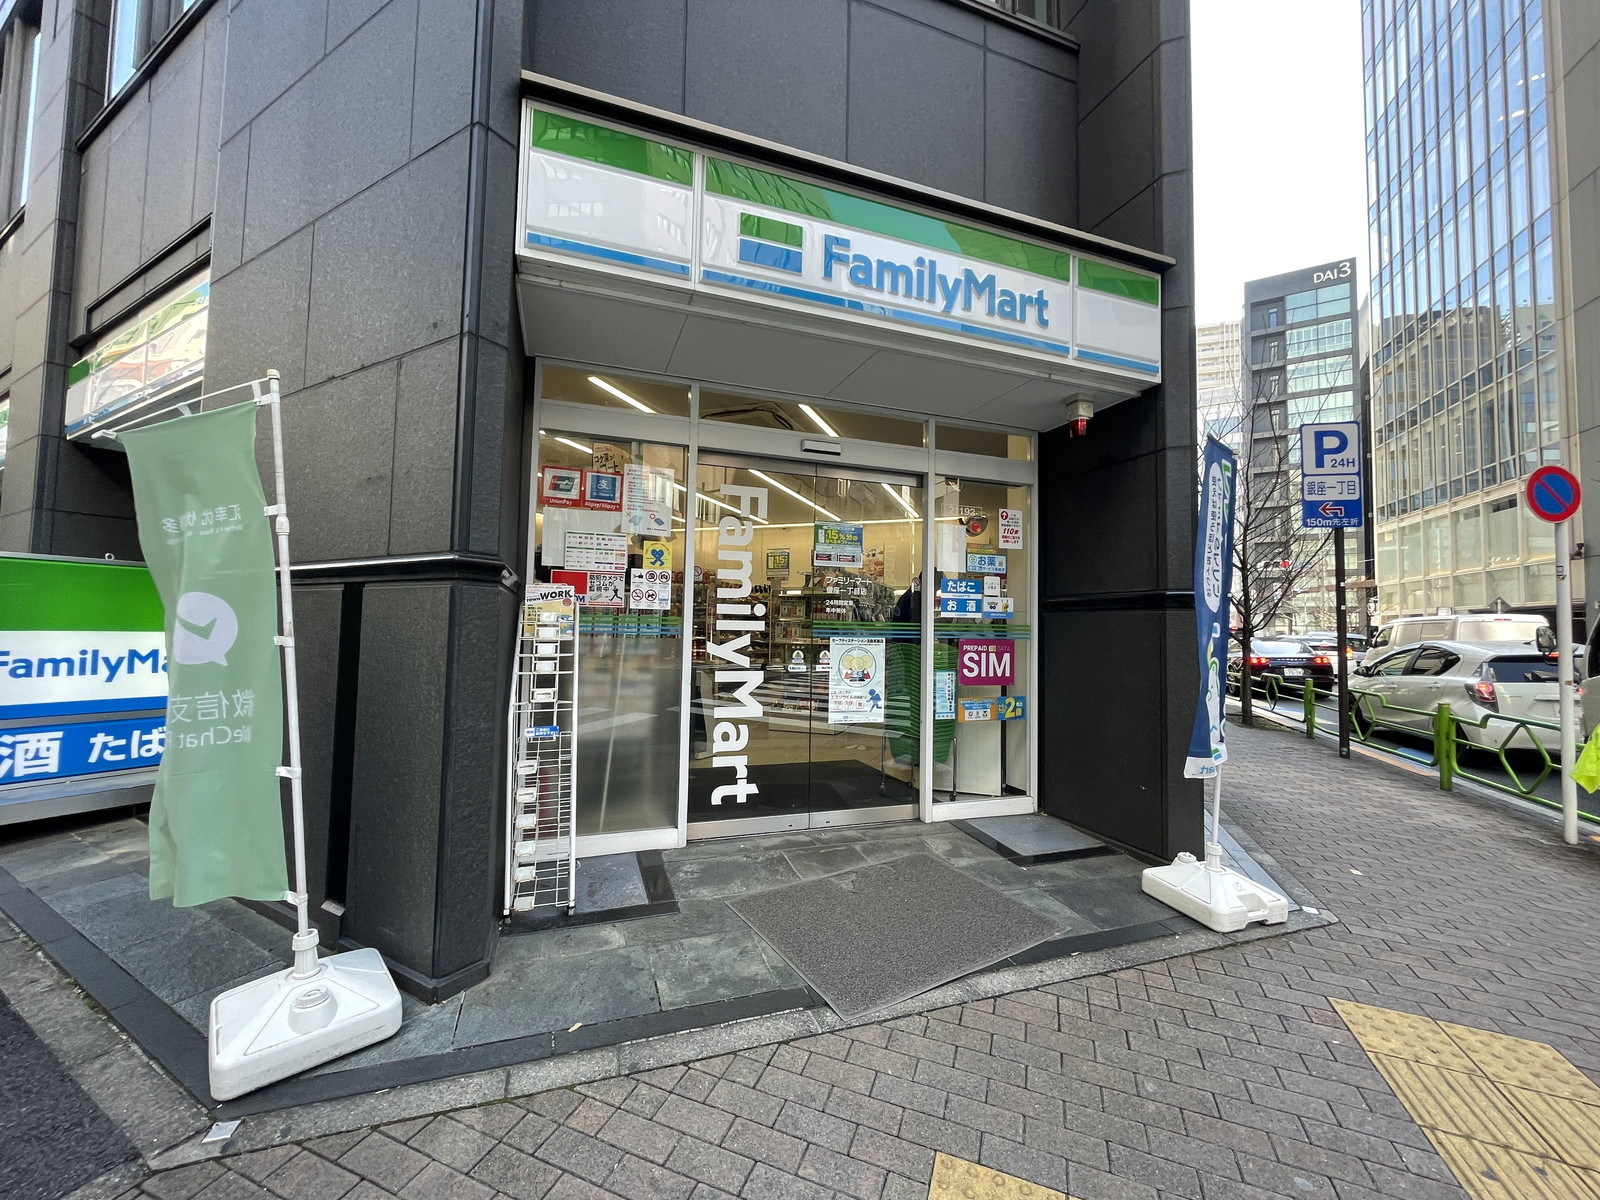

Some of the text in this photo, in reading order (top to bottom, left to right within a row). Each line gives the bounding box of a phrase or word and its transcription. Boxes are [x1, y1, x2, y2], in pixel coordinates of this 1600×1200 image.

[822, 234, 1050, 328] FamilyMart
[1314, 430, 1348, 468] P
[1331, 458, 1355, 468] 24H
[1306, 481, 1356, 496] 銀座一丁目
[549, 498, 573, 506] UnionPay
[1306, 518, 1359, 527] 150m先左折
[977, 556, 996, 567] お薬
[589, 574, 624, 582] 防犯カメラで
[826, 576, 872, 586] ファミリーマート
[947, 581, 976, 592] たばこ
[540, 589, 573, 601] WORK
[947, 599, 976, 611] お酒
[707, 484, 768, 805] FamilyMart
[962, 652, 1011, 678] SIM
[0, 731, 64, 778] 酒
